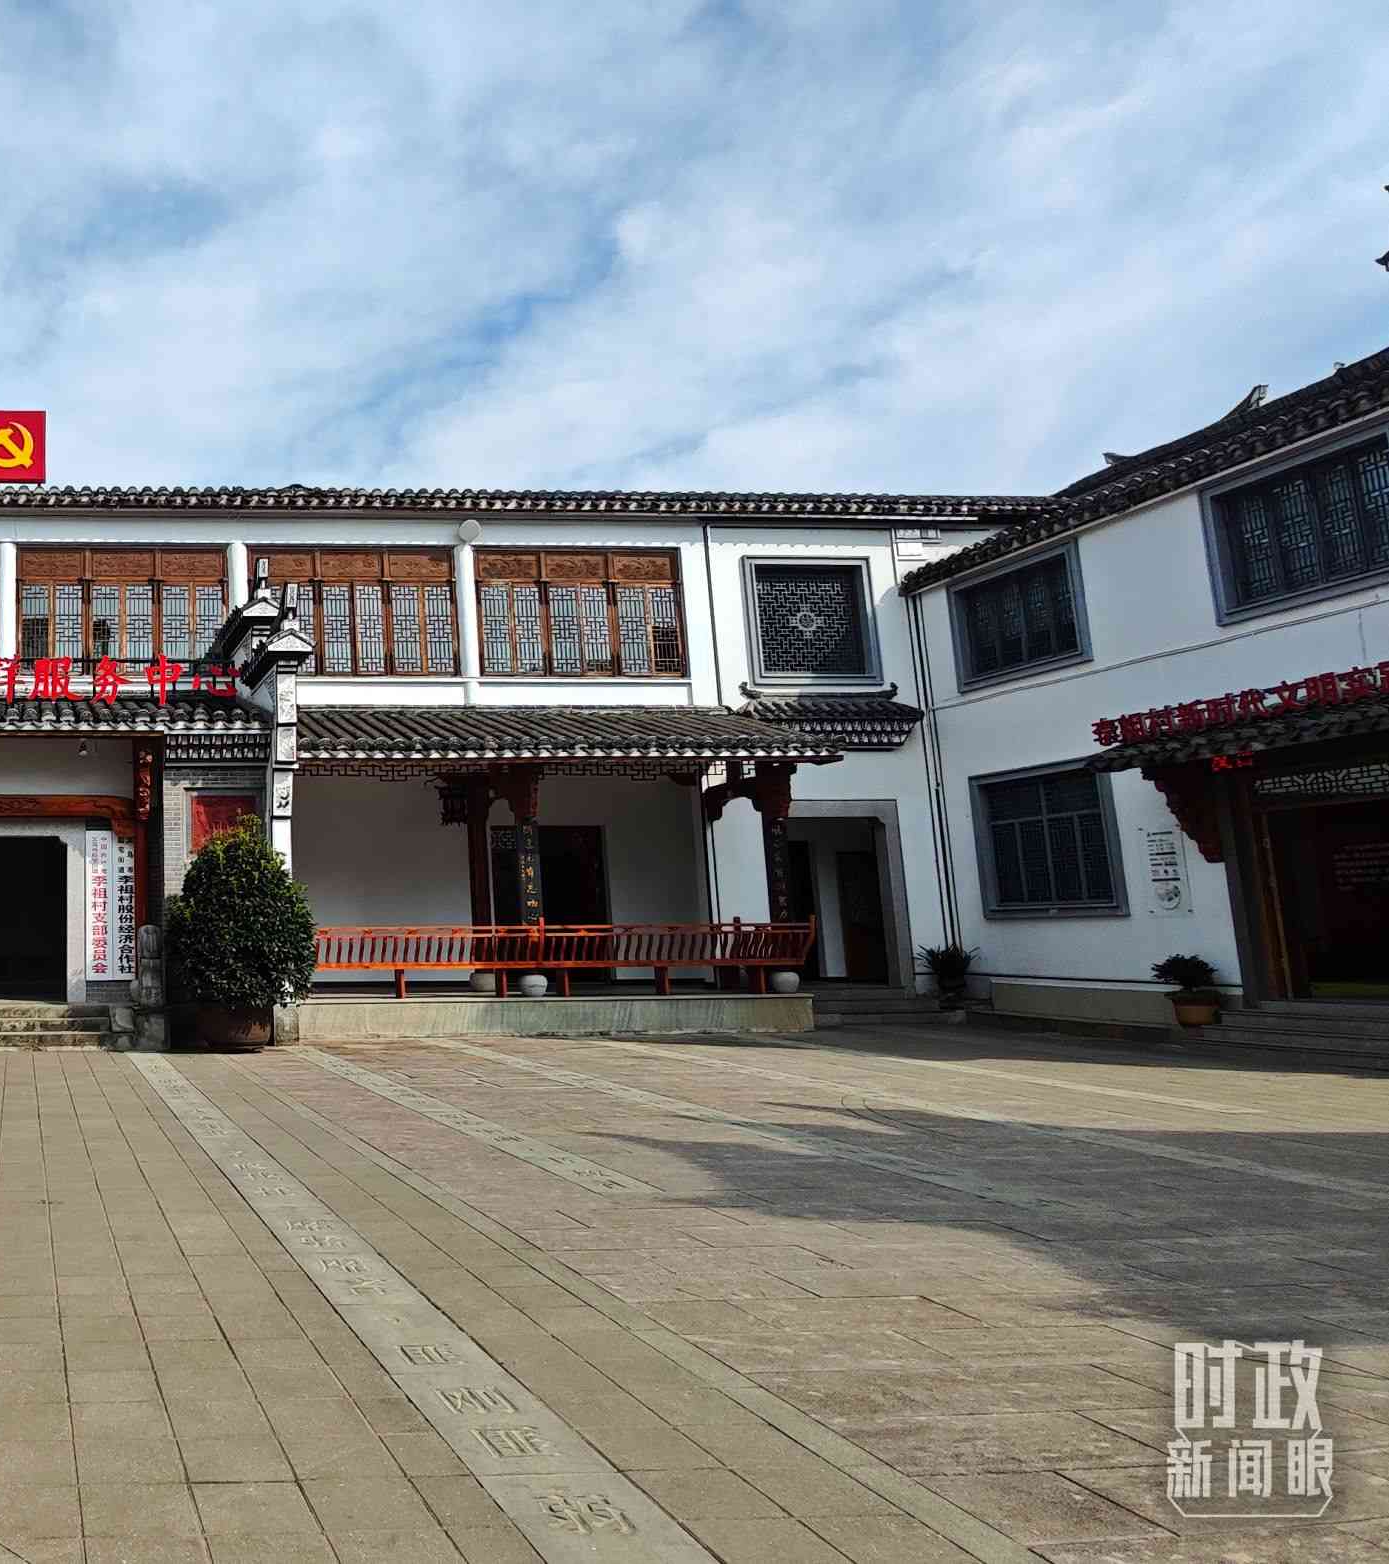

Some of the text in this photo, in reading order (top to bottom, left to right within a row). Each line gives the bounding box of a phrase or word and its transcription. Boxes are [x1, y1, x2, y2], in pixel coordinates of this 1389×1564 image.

[91, 876, 108, 974] 李祖村支部委员会
[117, 876, 134, 974] 李祖村股份经济合作社
